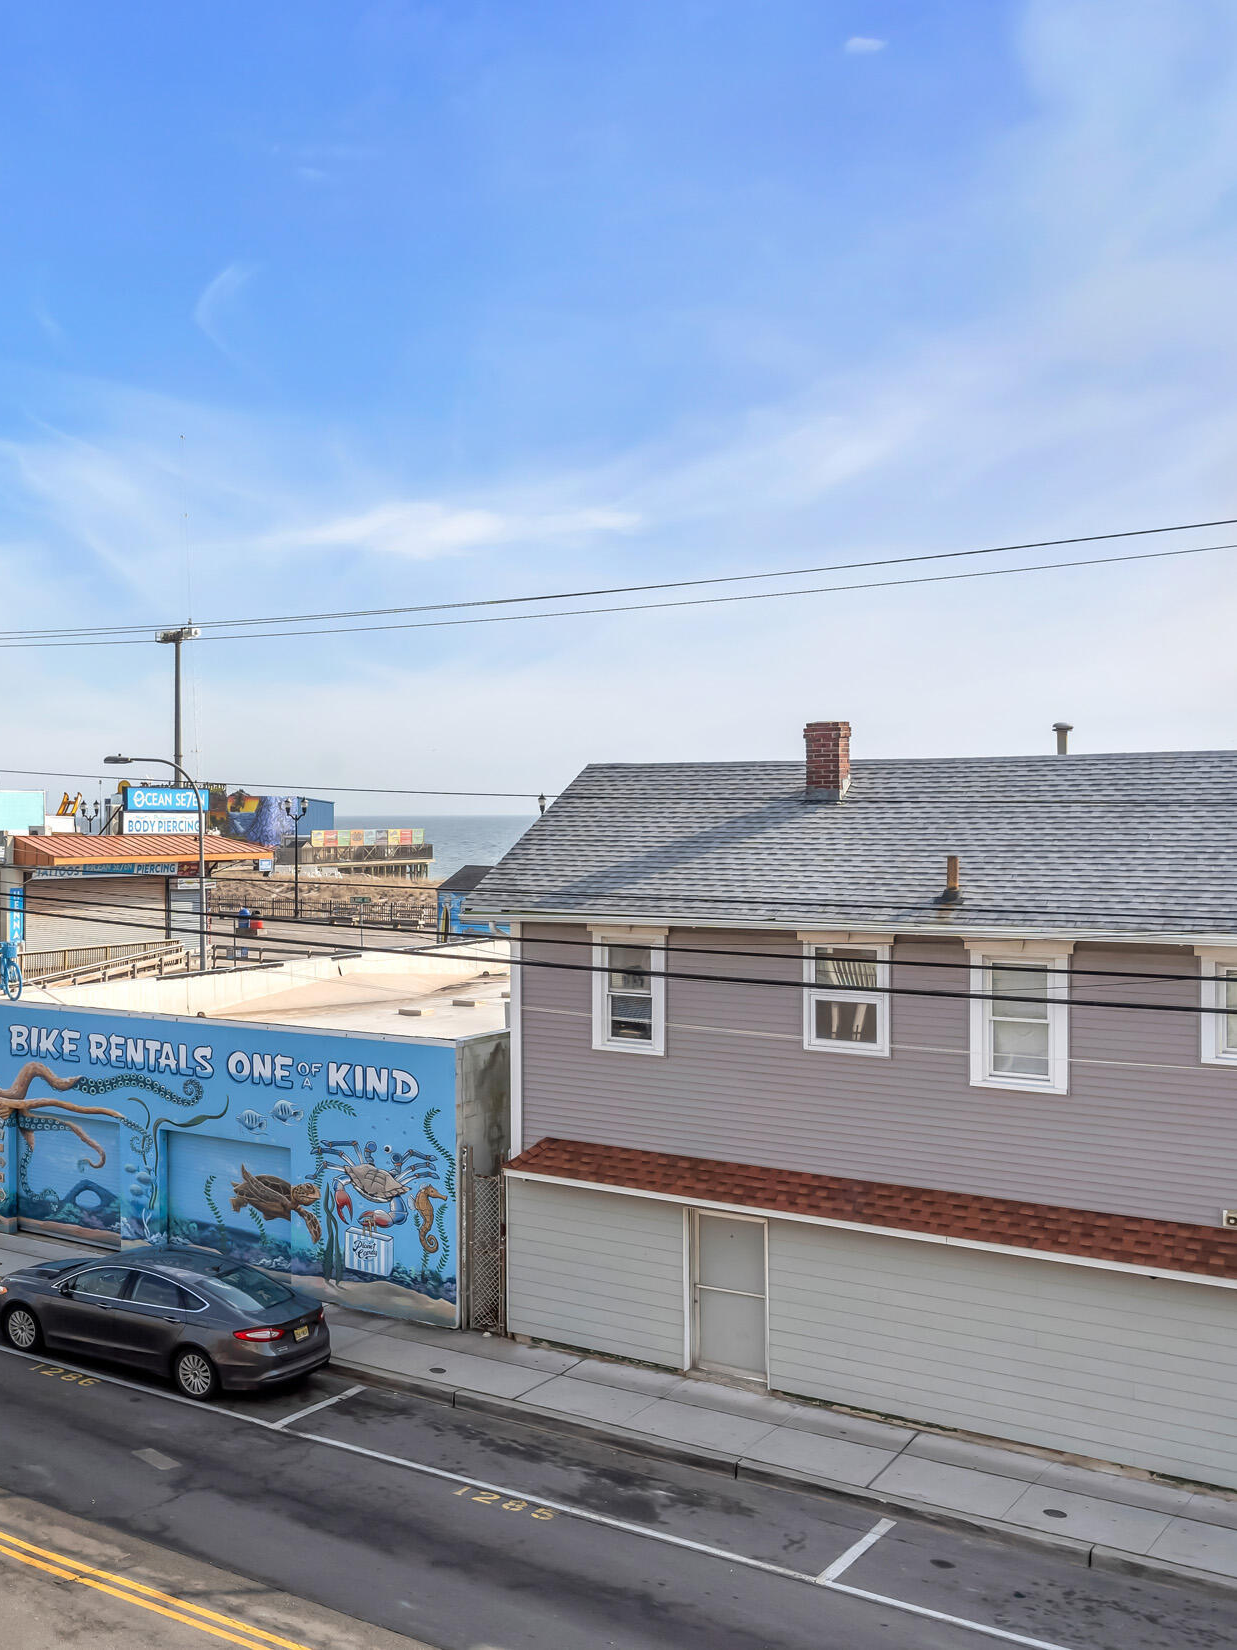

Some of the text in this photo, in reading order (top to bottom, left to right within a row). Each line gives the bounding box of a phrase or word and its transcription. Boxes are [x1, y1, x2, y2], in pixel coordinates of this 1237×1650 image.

[133, 790, 172, 808] OCEAN
[128, 820, 200, 832] BODY PIERCING
[136, 863, 176, 874] PIERCING
[13, 890, 21, 940] HENNA
[9, 1024, 420, 1104] BIKE RENTALS ONE OF KIND
[301, 1077, 313, 1090] A
[353, 1240, 377, 1252] Planet
[28, 1363, 102, 1387] 1286
[451, 1485, 563, 1521] 1285
